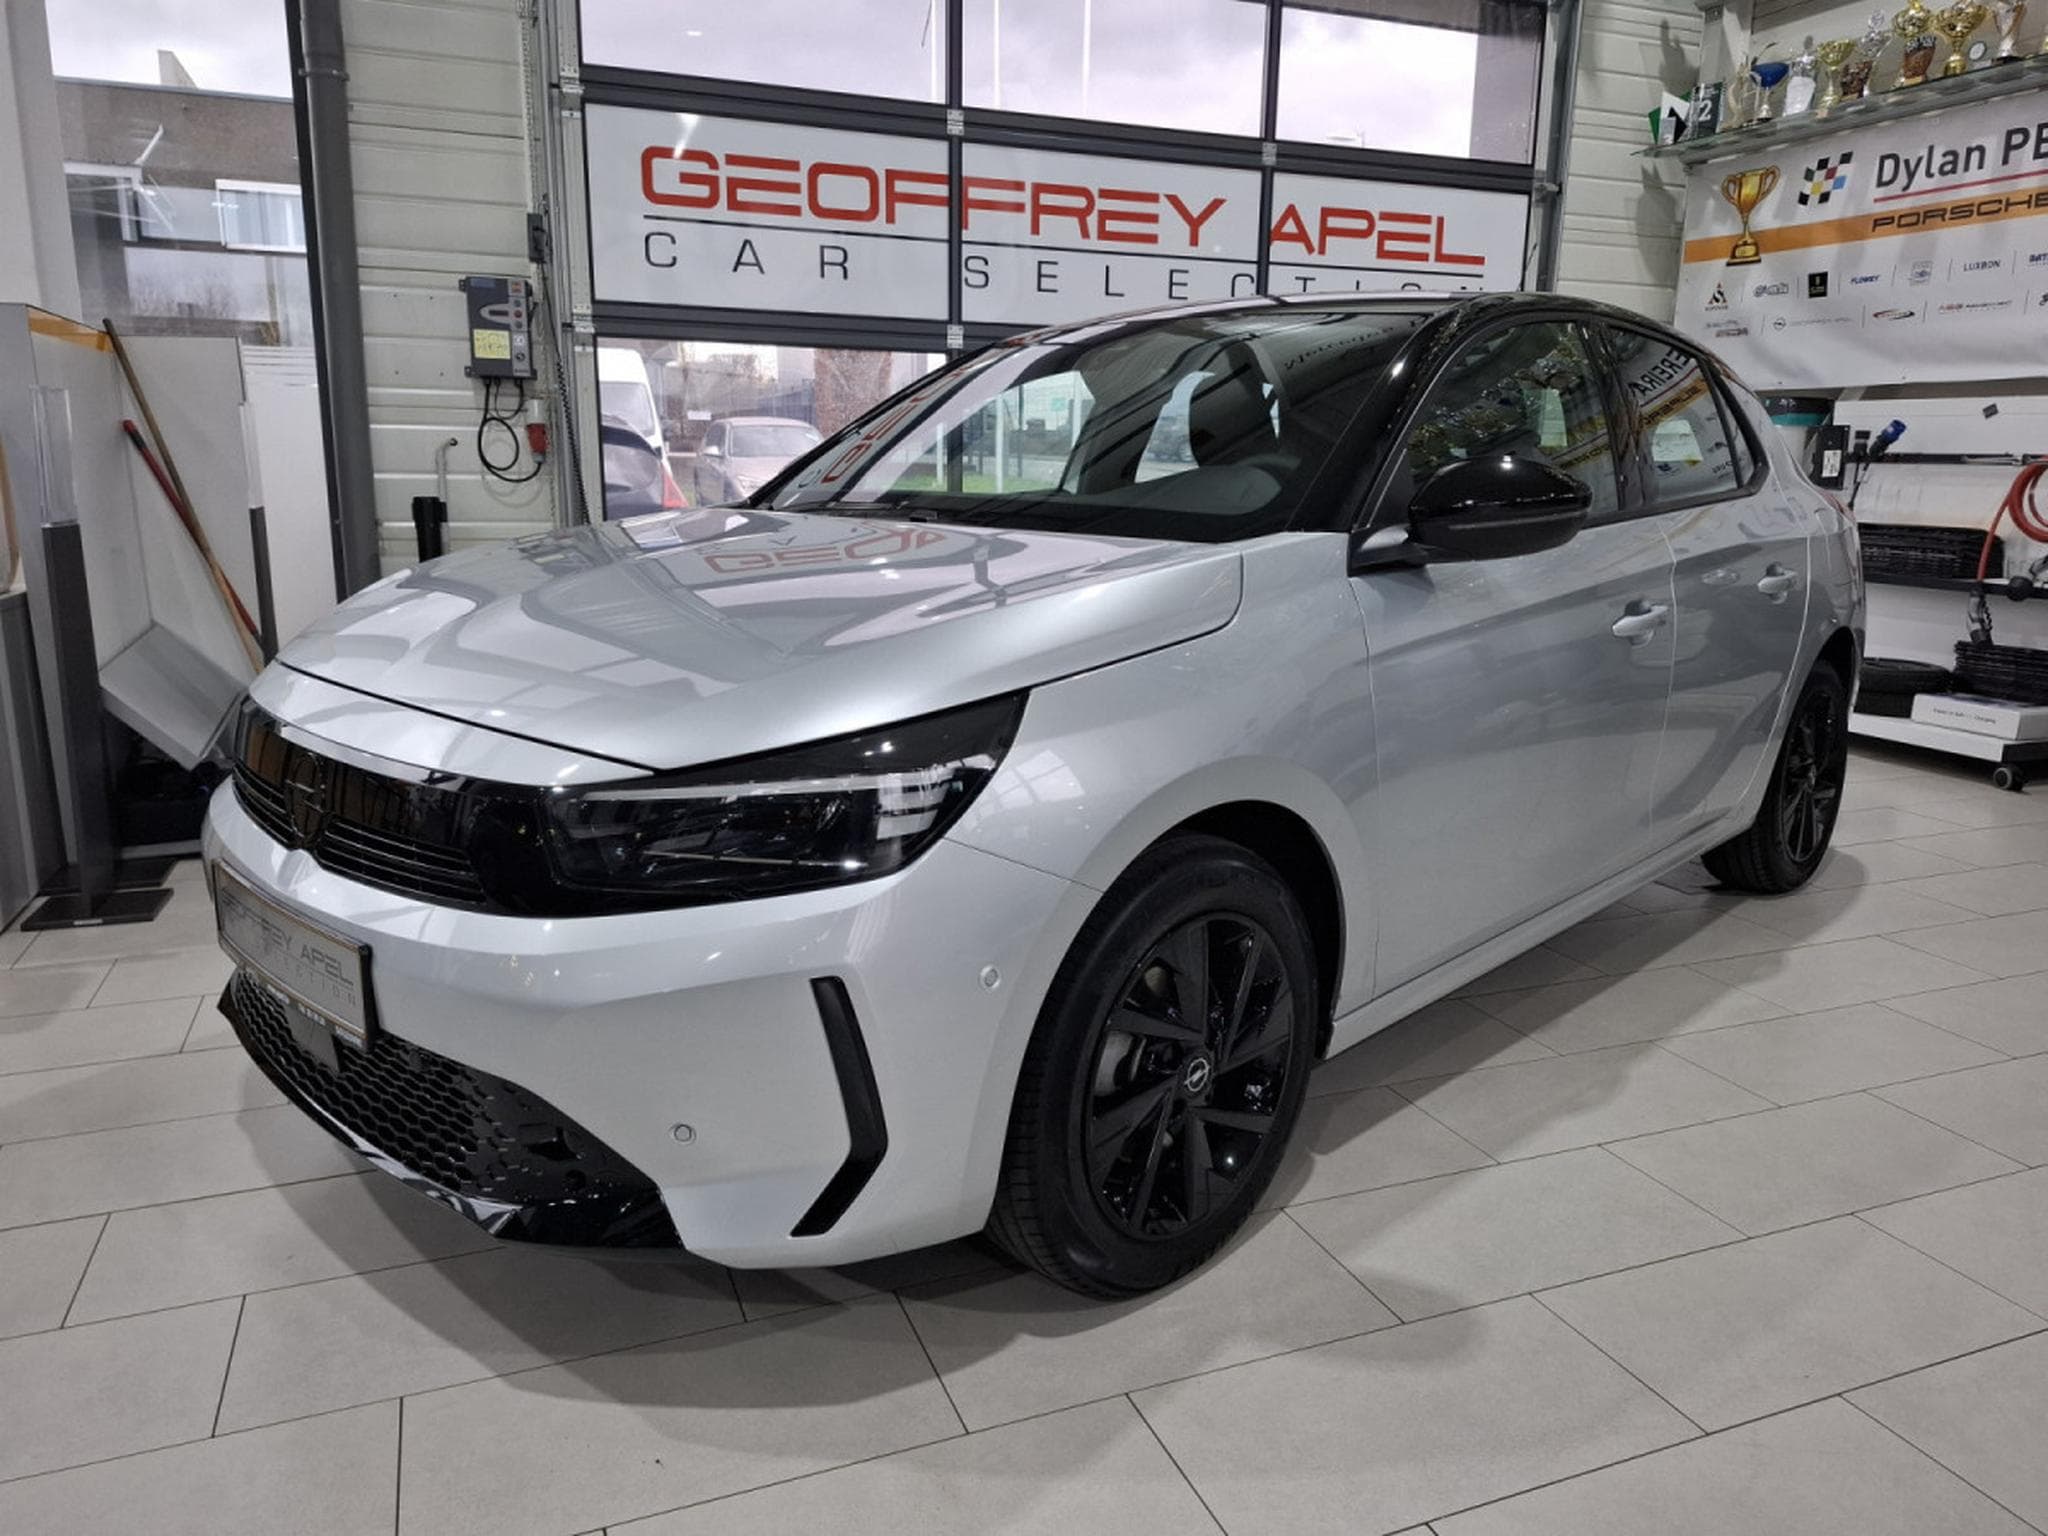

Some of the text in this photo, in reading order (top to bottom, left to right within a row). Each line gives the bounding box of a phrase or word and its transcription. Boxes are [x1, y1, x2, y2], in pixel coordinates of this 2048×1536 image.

[1876, 122, 2048, 192] Dylan PE
[641, 145, 1485, 266] GEOFFREY APEL
[1872, 192, 2048, 233] PORSCHE
[644, 231, 849, 281] CAR
[301, 943, 355, 987] APEL
